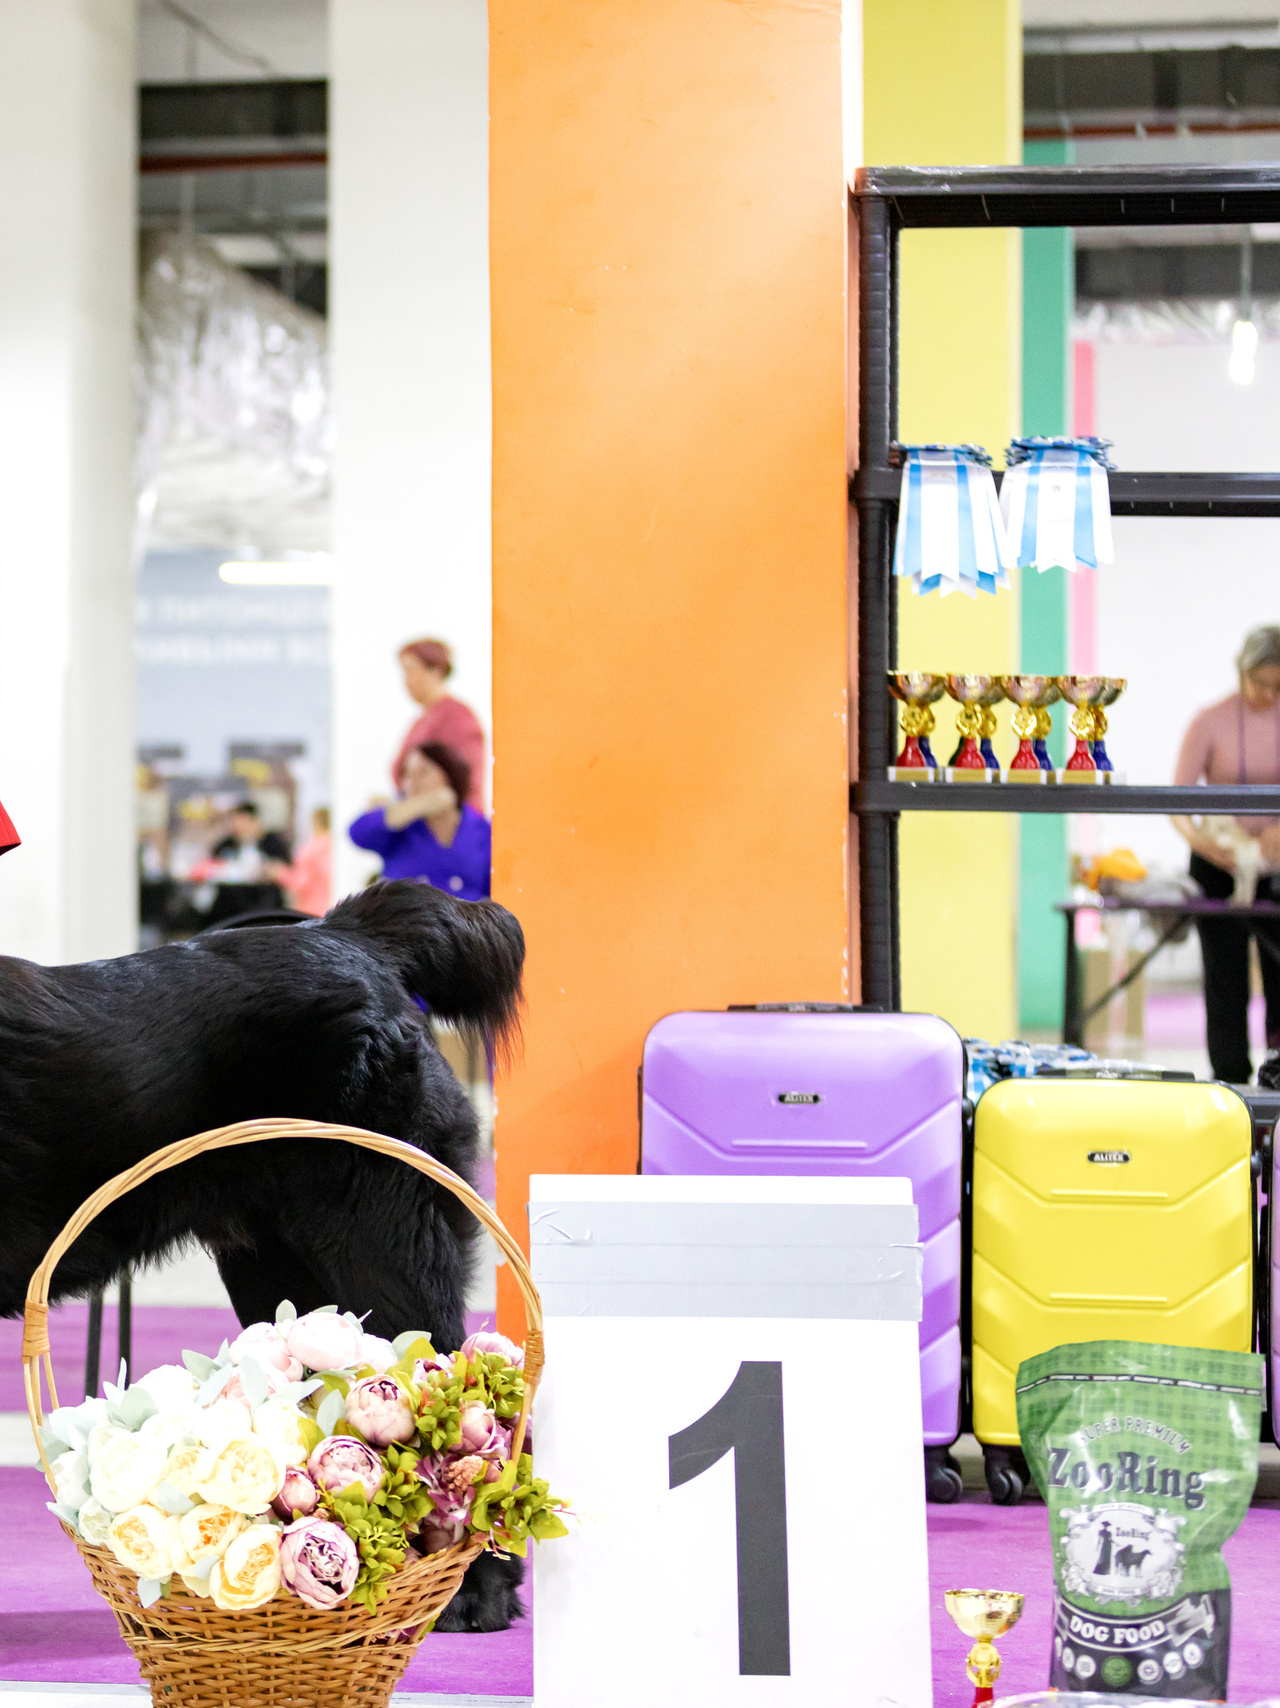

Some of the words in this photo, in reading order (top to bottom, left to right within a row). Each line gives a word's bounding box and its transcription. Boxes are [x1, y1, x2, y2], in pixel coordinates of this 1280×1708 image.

[1124, 1415, 1193, 1455] PREMIUM
[1048, 1447, 1207, 1511] ZooRing
[668, 1360, 791, 1676] 1
[1069, 1615, 1110, 1642] DOG
[1113, 1620, 1165, 1644] FOOD
